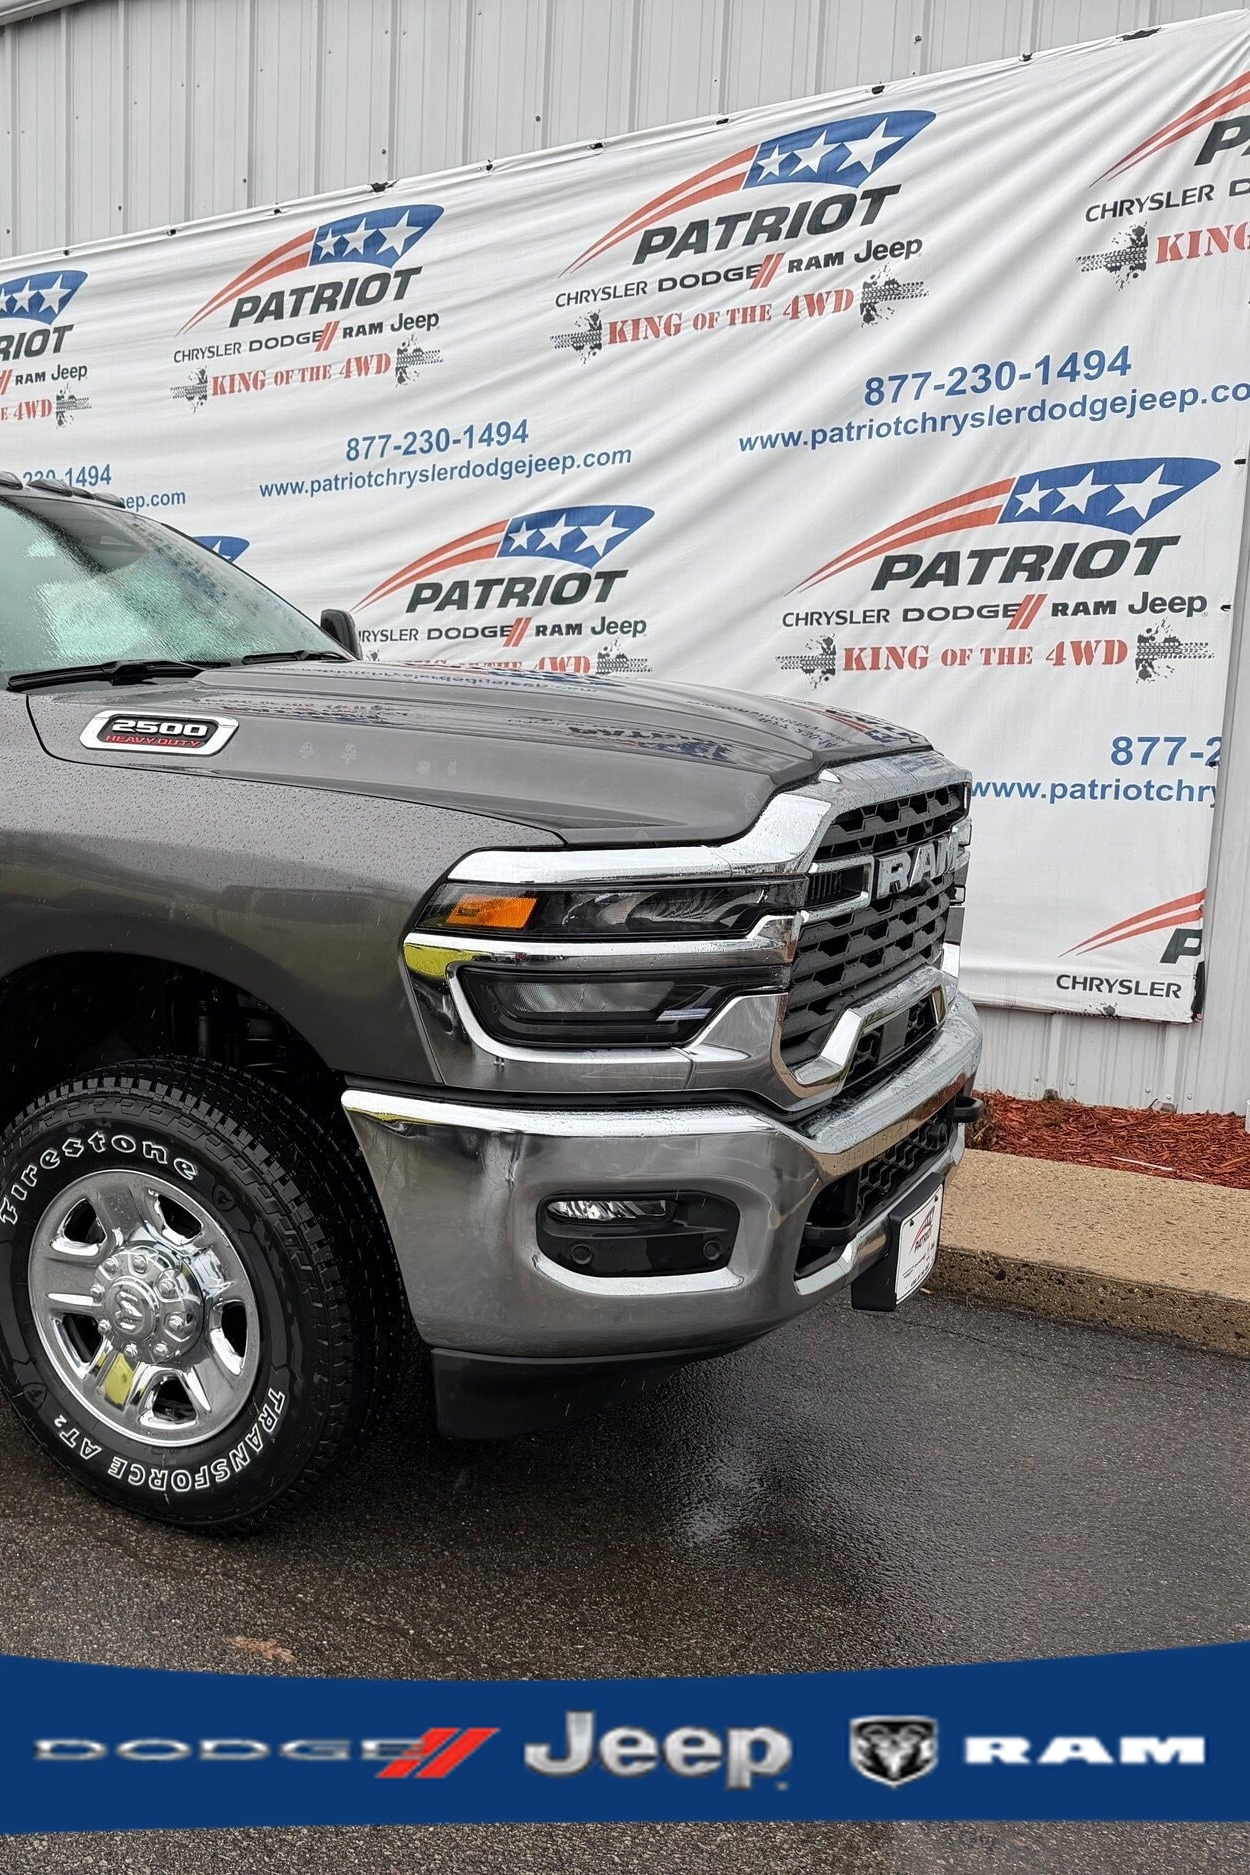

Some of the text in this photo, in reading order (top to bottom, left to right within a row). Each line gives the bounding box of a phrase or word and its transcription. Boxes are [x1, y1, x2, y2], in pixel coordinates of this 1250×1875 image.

[632, 184, 902, 265] PATRIOT
[1085, 184, 1215, 222] CHRYSLER
[555, 235, 923, 308] CHRYSLER DODGE RAM Jeep
[228, 266, 422, 328] PATRIOT
[608, 288, 855, 345] KING OF THE 4WD
[173, 312, 439, 364] CHRYSLER DODGE RAM Jeep
[15, 371, 46, 386] RAM
[51, 364, 88, 381] Jeep
[211, 352, 391, 396] KING OF THE 4WD
[864, 345, 1131, 406] 877-230-1494
[13, 399, 53, 420] 4WD
[738, 382, 1250, 451] www.patriotchryslerdodgejeep.co
[346, 419, 529, 461] 877-230-1494
[259, 446, 632, 498] www.patriotchryslerdodgejeep.com
[871, 535, 1181, 591] PATRIOT
[406, 570, 628, 613] PATRIOT
[782, 592, 1207, 628] CHRYSLER DODGE RAM Jeep
[427, 625, 513, 640] DODGE
[535, 623, 583, 637] RAM
[591, 616, 647, 638] Jeep
[843, 639, 1128, 671] KING OF THE 4WD
[105, 735, 201, 747] HEAVY DUTY
[112, 719, 208, 737] 2500
[1110, 736, 1222, 767] 877-2
[877, 835, 959, 899] RAM
[1056, 974, 1182, 999] CHRYSLER
[108, 1386, 285, 1493] TRANSFORCE
